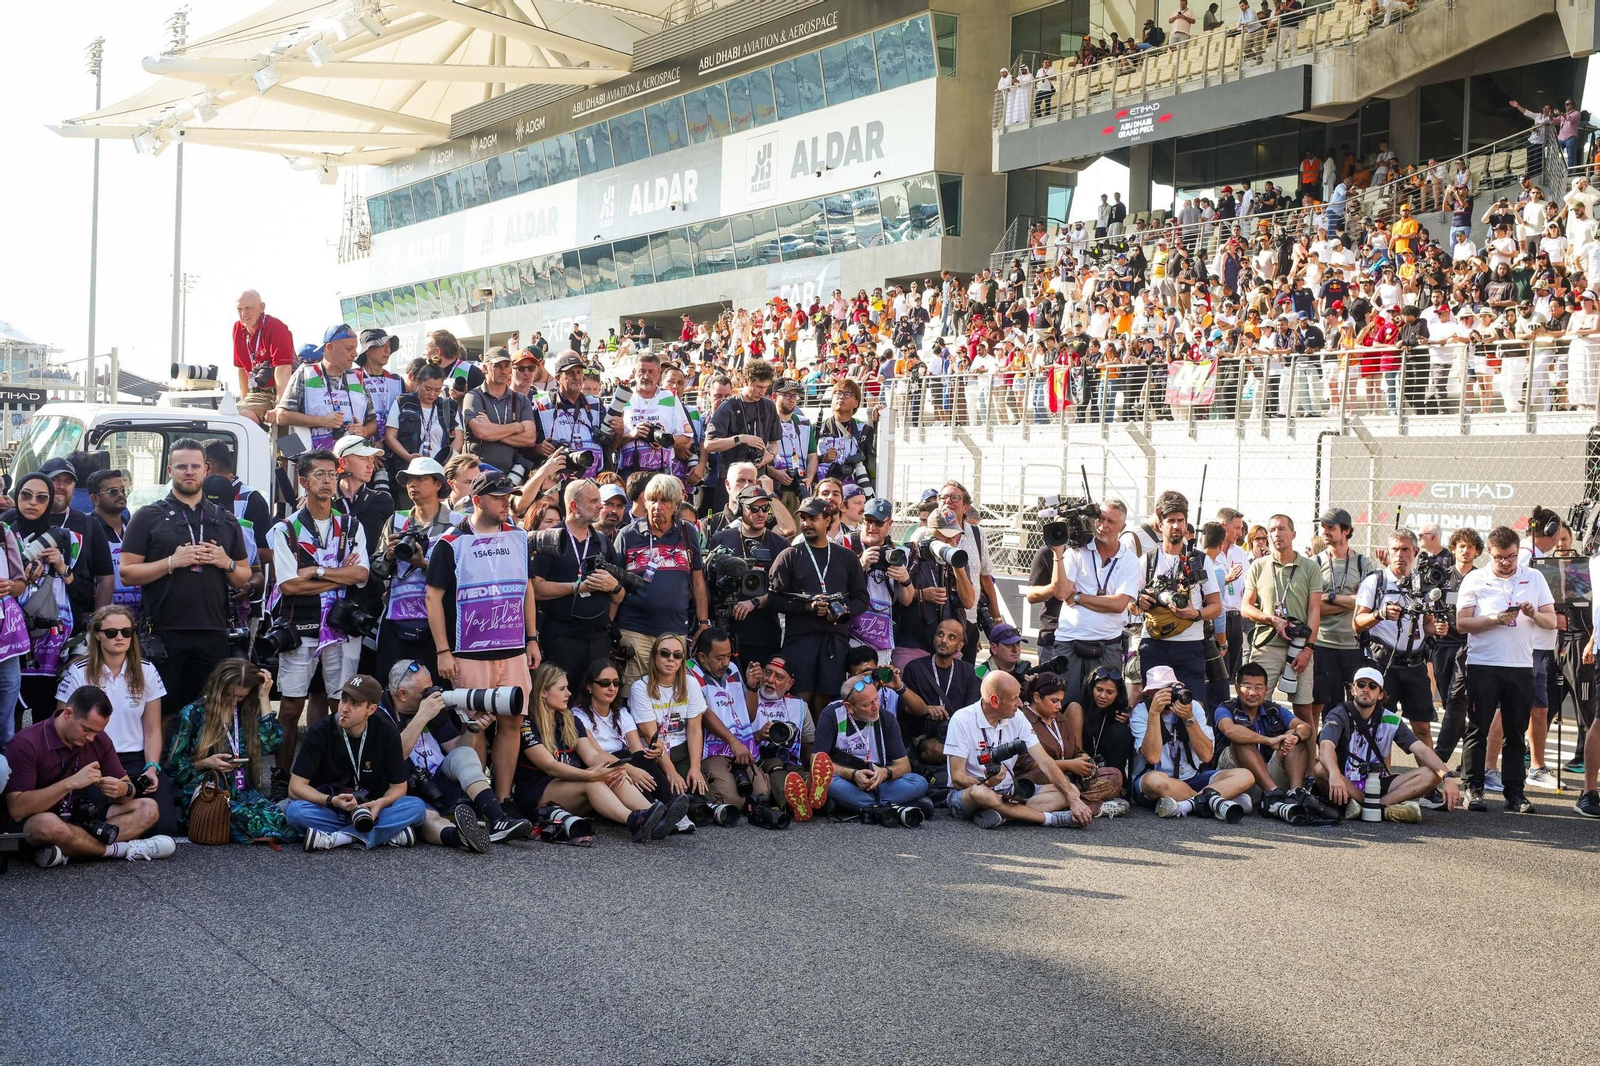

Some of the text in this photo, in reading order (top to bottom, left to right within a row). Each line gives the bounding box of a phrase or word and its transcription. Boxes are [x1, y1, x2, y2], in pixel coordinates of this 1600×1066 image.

[699, 11, 838, 71] ABU DHABI AVIATION & AEROSPACE
[572, 100, 585, 115] ABU
[585, 93, 606, 111] DHABI
[606, 81, 636, 103] AVIATION
[642, 66, 681, 91] AEROSPACE
[1130, 103, 1160, 115] ETIHAD
[525, 116, 546, 135] ADGM
[1118, 125, 1154, 138] GRAND PRIX
[1120, 121, 1134, 131] ABU
[478, 133, 498, 150] ADGM
[790, 120, 885, 180] ALDAR
[436, 149, 454, 166] ADGM
[398, 163, 414, 177] ADGM
[627, 168, 698, 218] ALDAR
[750, 181, 771, 194] ALDAR
[504, 206, 559, 246] ALDAR
[1431, 482, 1515, 499] ETIHAD
[1405, 513, 1492, 531] ABU DHABI
[473, 547, 510, 559] 1546-ABU
[457, 584, 502, 601] MEDIA
[1162, 621, 1177, 632] NIKE
